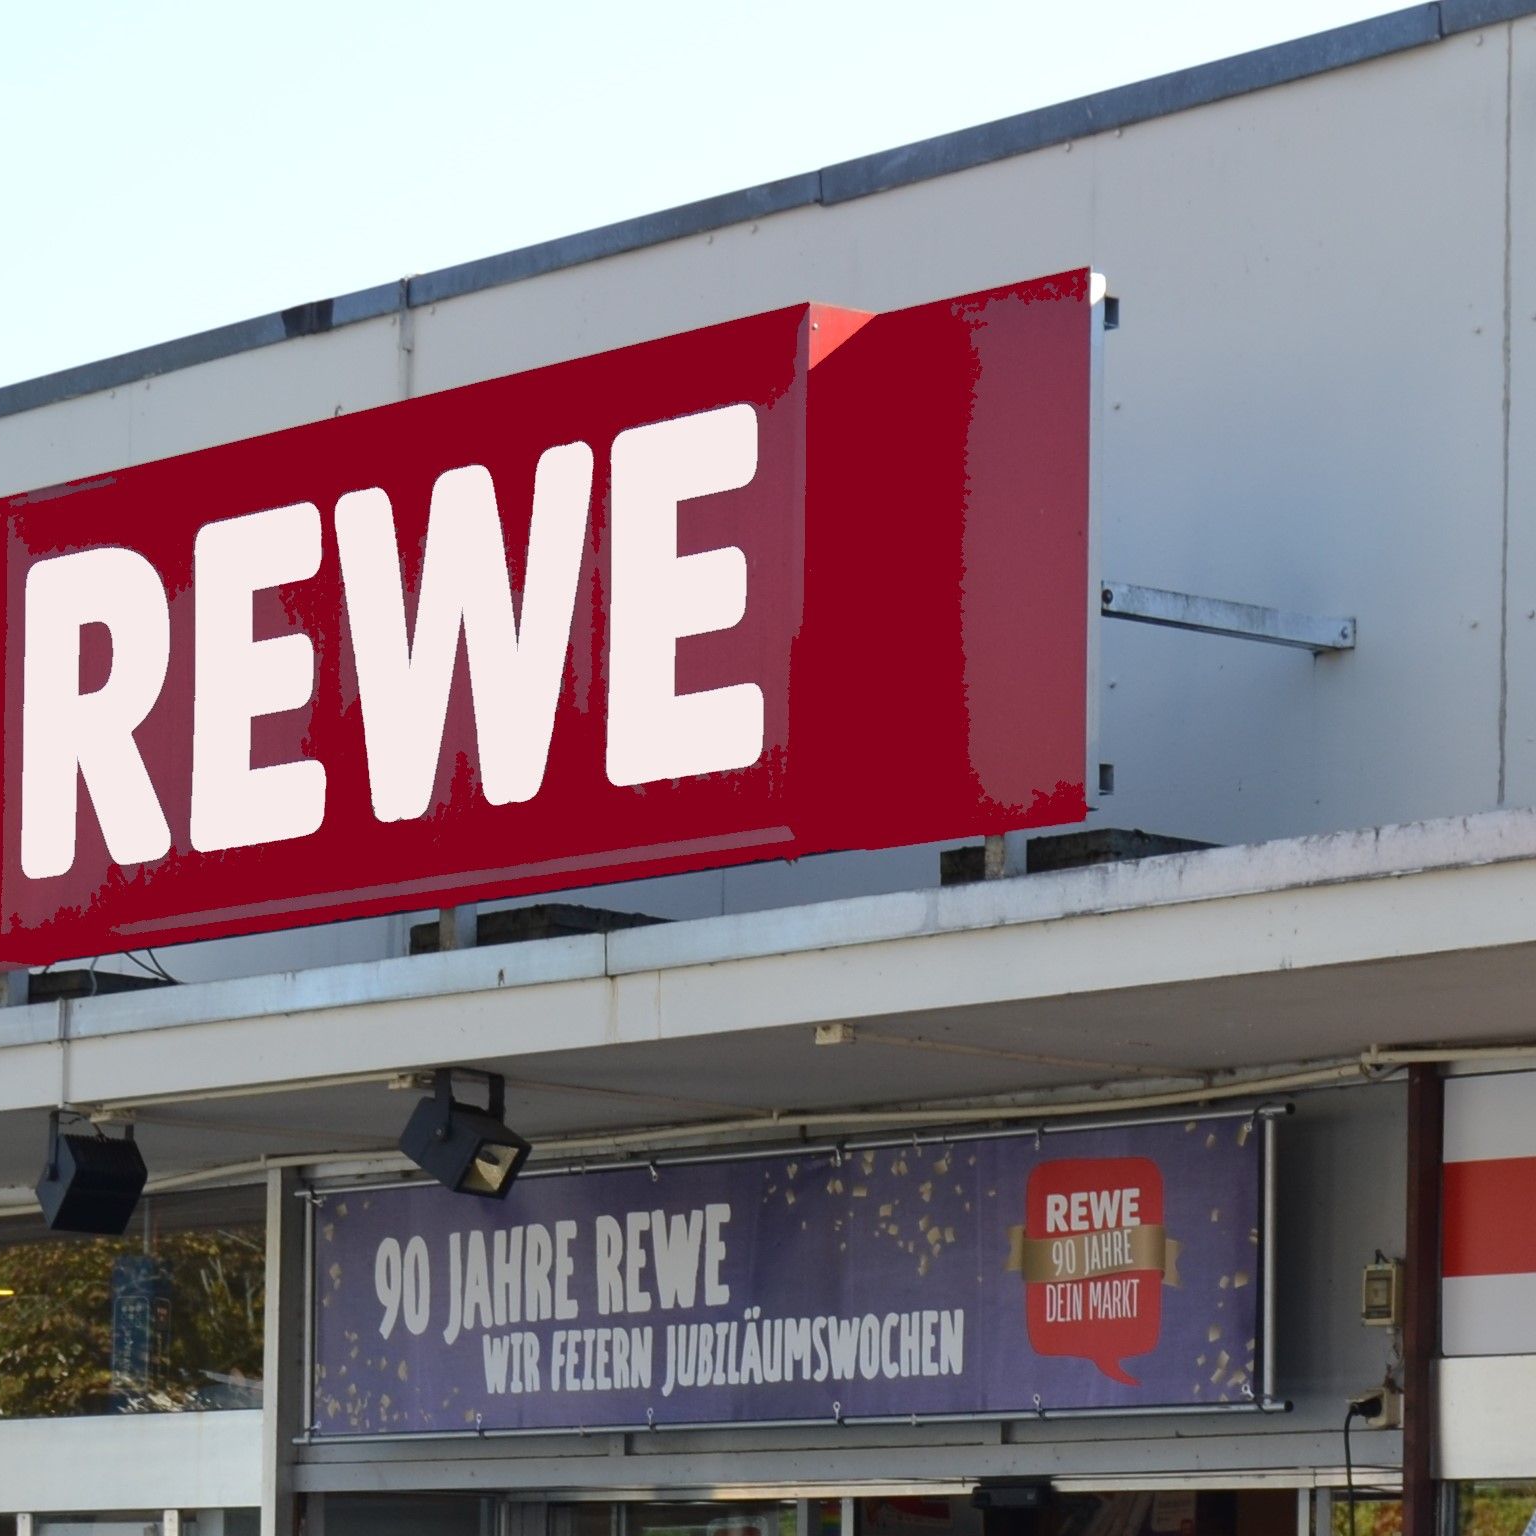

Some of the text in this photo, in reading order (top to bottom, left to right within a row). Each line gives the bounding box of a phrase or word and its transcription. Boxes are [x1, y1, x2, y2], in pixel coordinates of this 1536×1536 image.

[20, 402, 766, 881] REWE
[1045, 1187, 1142, 1233] REWE
[374, 1203, 732, 1345] 90 JAHRE REWE
[1051, 1229, 1133, 1277] 90 JAHRE
[1045, 1278, 1140, 1323] DEIN MARKT
[482, 1305, 964, 1397] WIR FEIERN JUBILÄUMSWOCHEN
